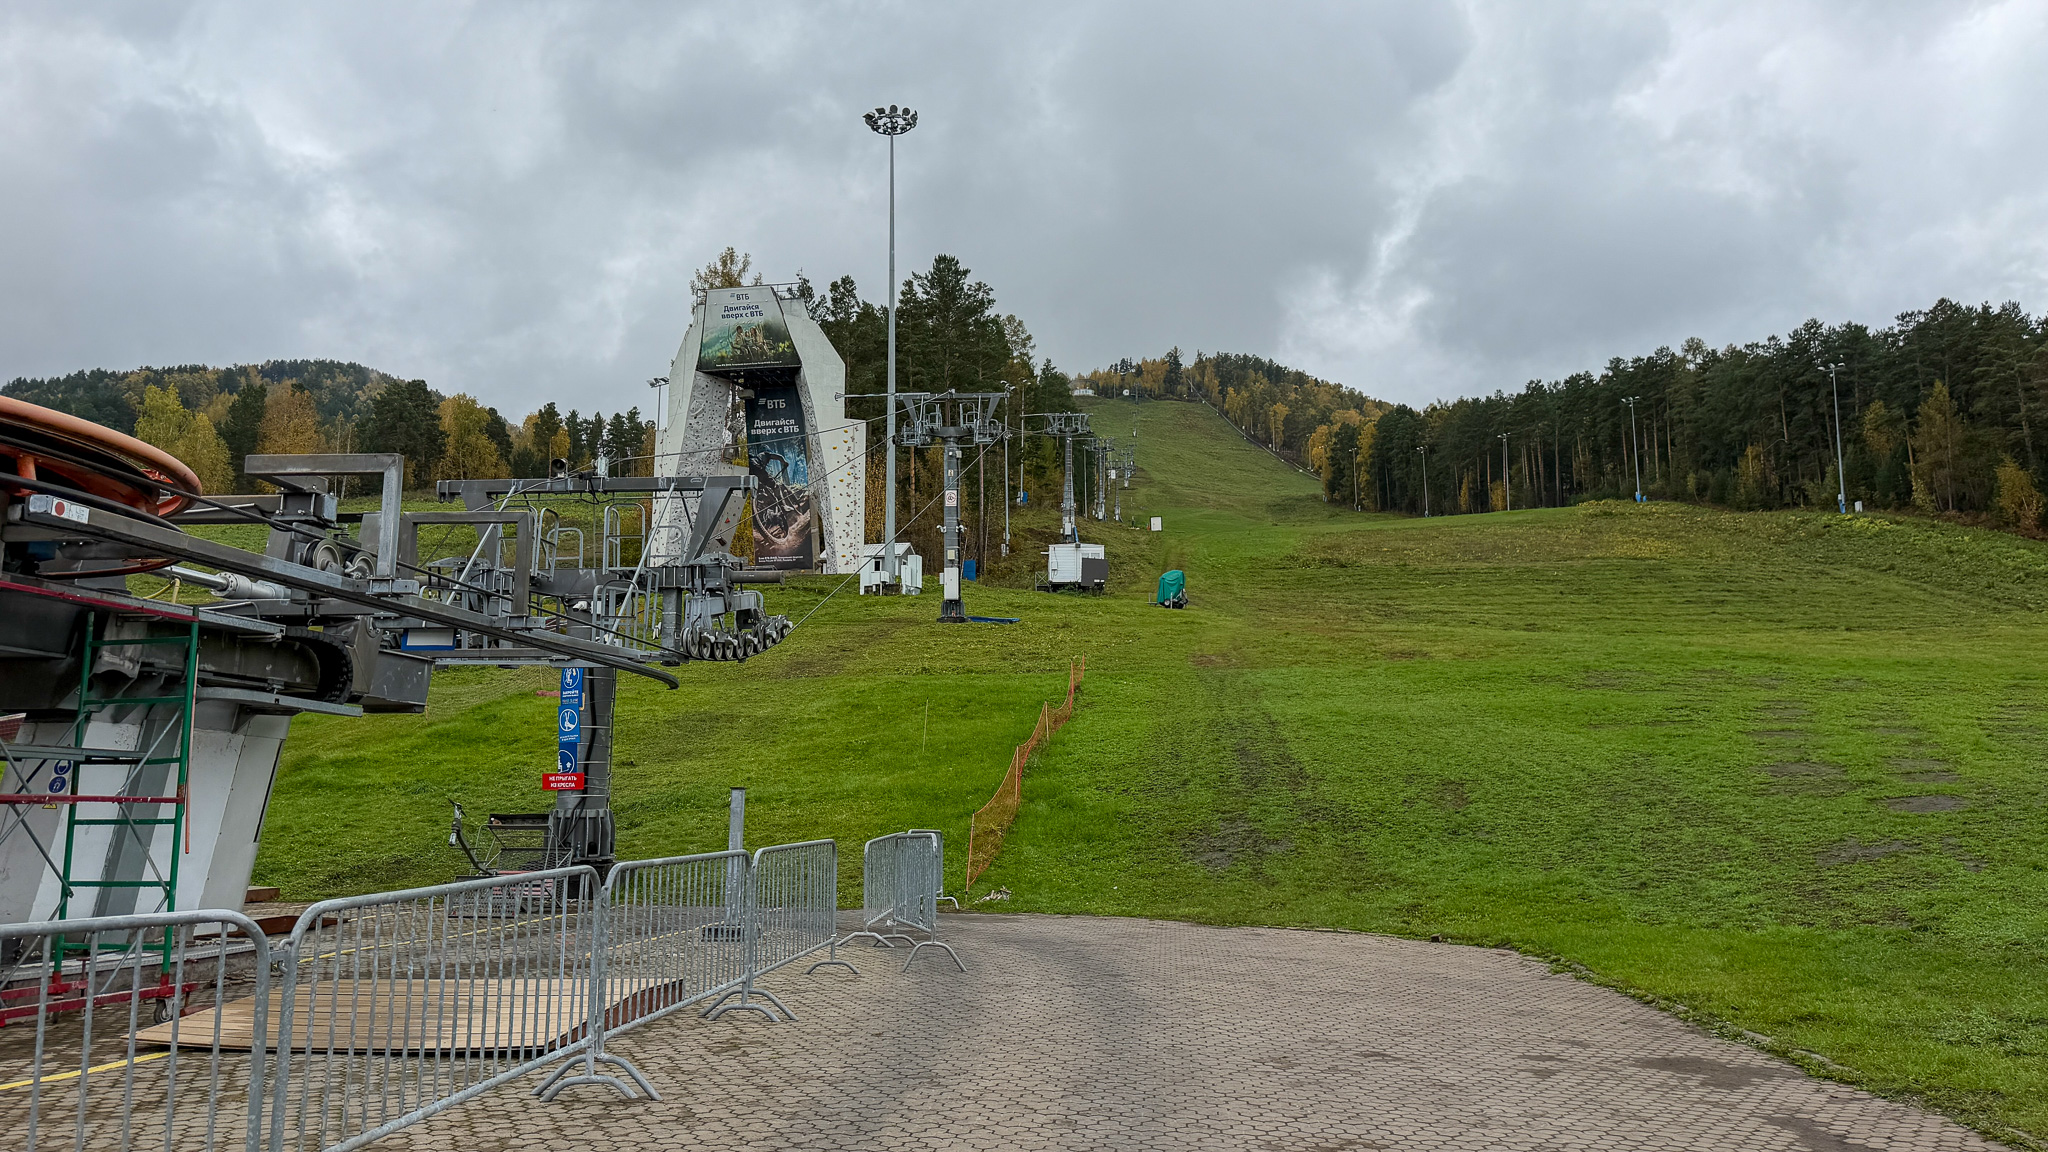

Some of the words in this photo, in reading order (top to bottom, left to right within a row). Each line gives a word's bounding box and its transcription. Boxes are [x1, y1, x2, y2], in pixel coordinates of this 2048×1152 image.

[724, 304, 760, 312] Двигайся
[766, 398, 786, 409] ВТБ
[754, 418, 795, 428] Двигайся
[751, 428, 776, 436] вверх
